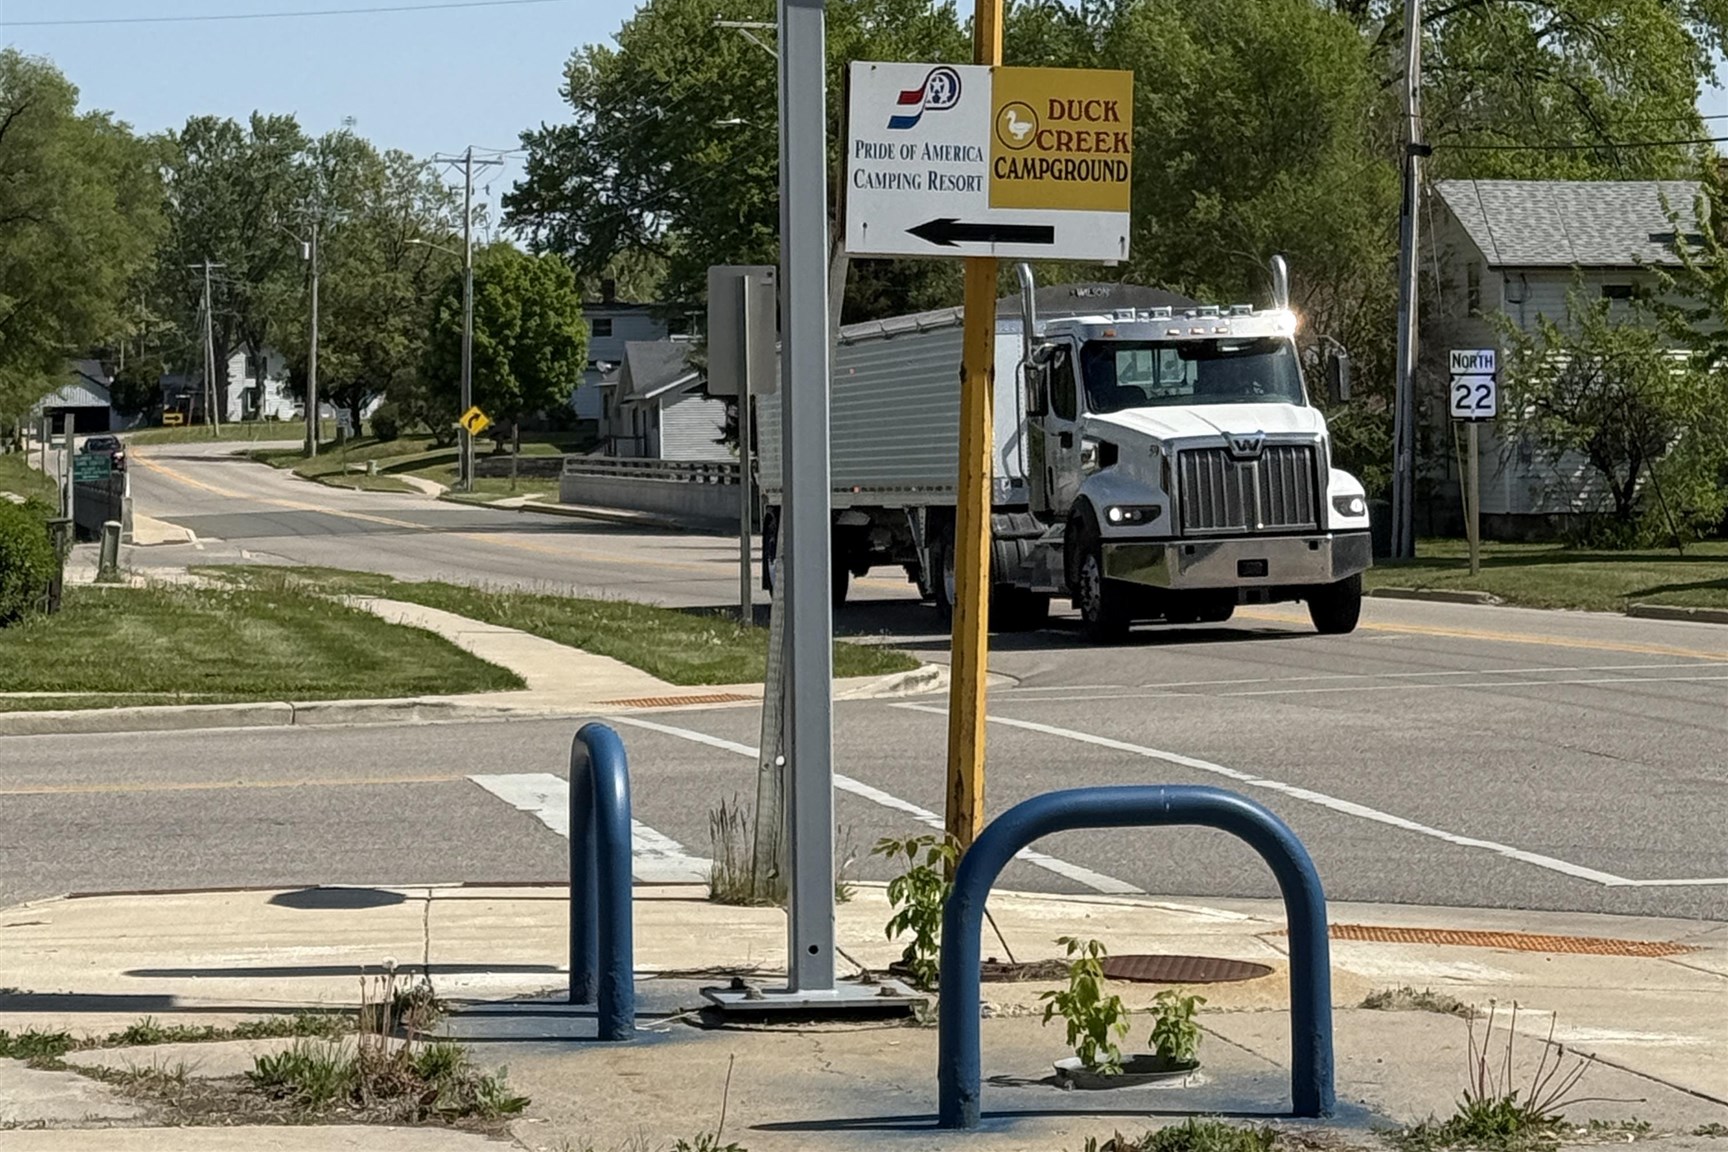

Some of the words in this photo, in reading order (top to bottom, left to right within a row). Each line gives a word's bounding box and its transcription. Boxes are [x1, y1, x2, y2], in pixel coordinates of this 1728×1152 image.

[1047, 99, 1120, 122] DUCK
[855, 140, 896, 160] PRIDE
[900, 144, 917, 160] OF
[921, 142, 983, 162] AMERICA
[1036, 129, 1131, 154] CREEK
[853, 168, 921, 190] CAMPING
[927, 170, 983, 192] RESORT
[994, 156, 1128, 182] CAMPGROUND
[1452, 353, 1493, 368] NORTH
[1455, 384, 1492, 409] 22
